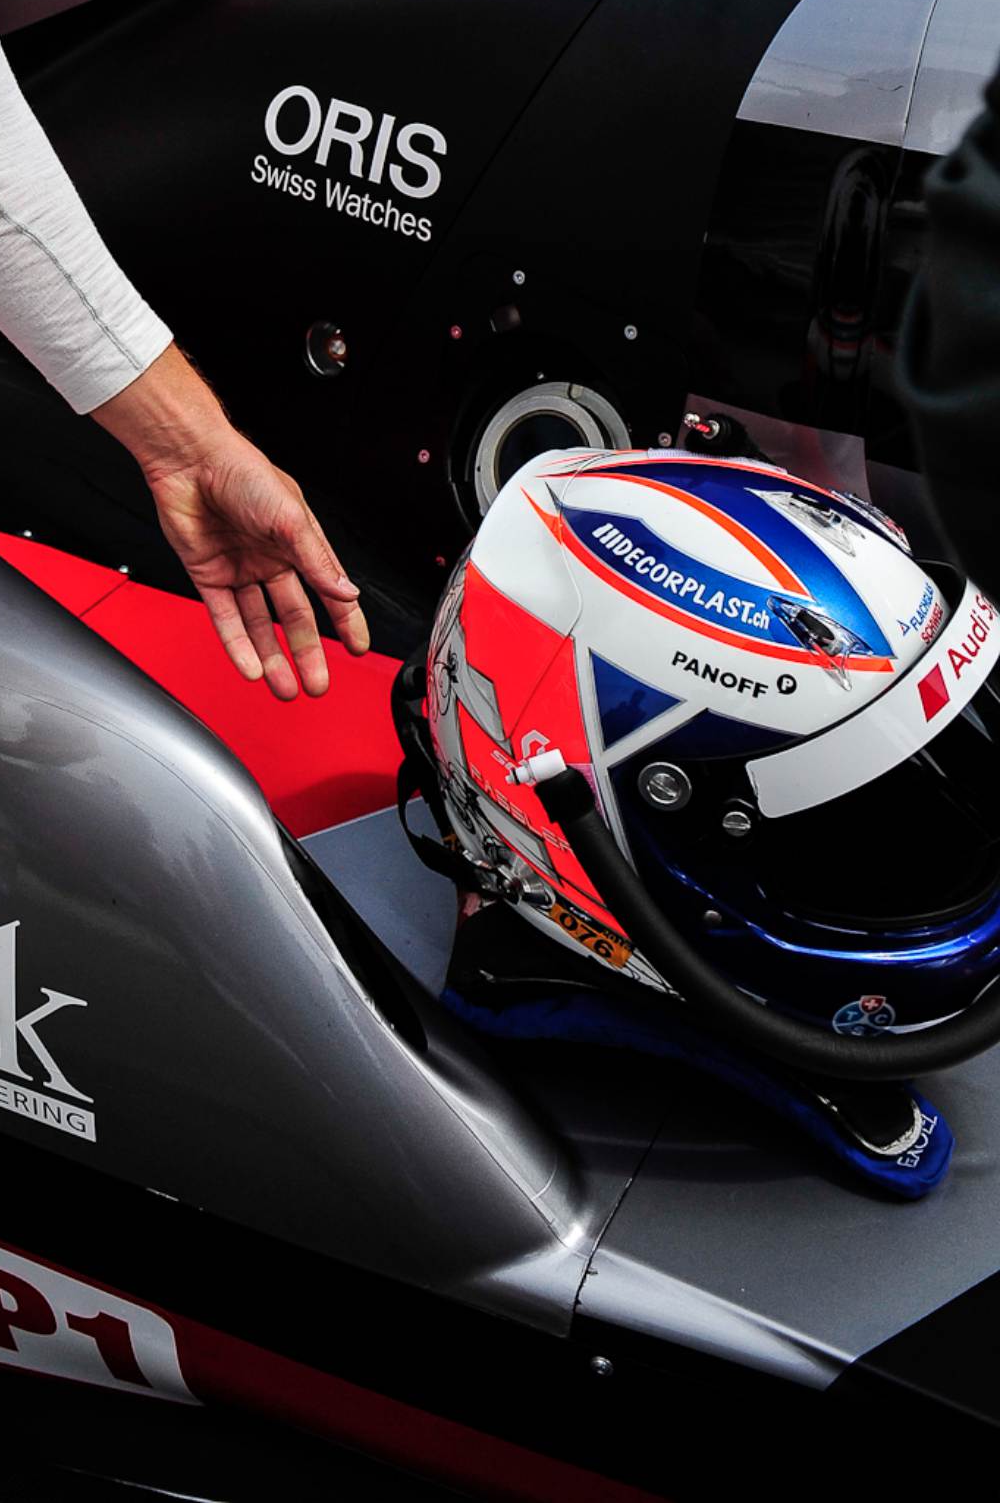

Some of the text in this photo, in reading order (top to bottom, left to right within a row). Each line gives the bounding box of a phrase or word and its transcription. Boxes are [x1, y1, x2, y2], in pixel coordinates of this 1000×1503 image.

[264, 84, 448, 200] ORIS
[250, 154, 433, 242] Swiss Watches
[671, 650, 769, 699] PANOFF
[947, 609, 991, 681] Audi
[559, 911, 615, 959] 076
